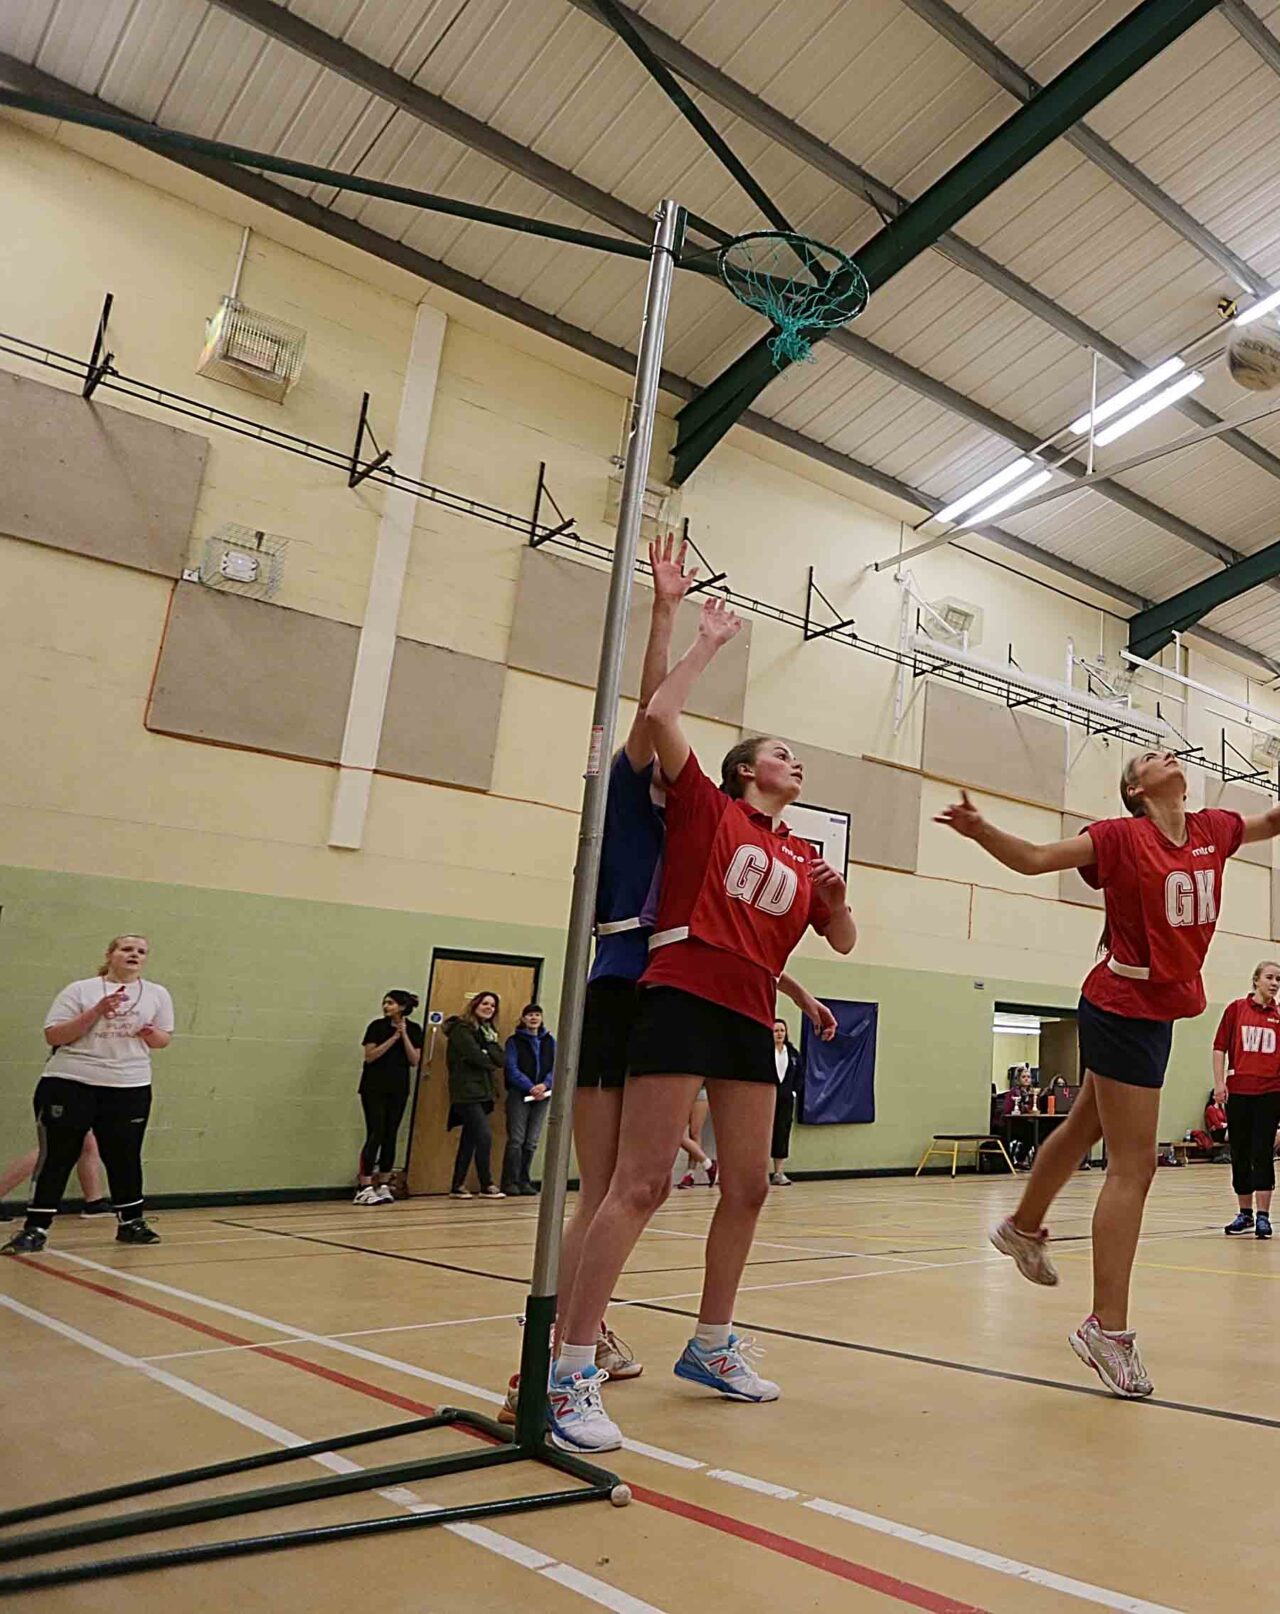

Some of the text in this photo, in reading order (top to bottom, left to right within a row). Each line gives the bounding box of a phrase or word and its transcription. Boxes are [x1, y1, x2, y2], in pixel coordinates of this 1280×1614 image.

[723, 843, 798, 916] GD
[1164, 869, 1217, 928] GK
[1240, 1025, 1277, 1054] WD
